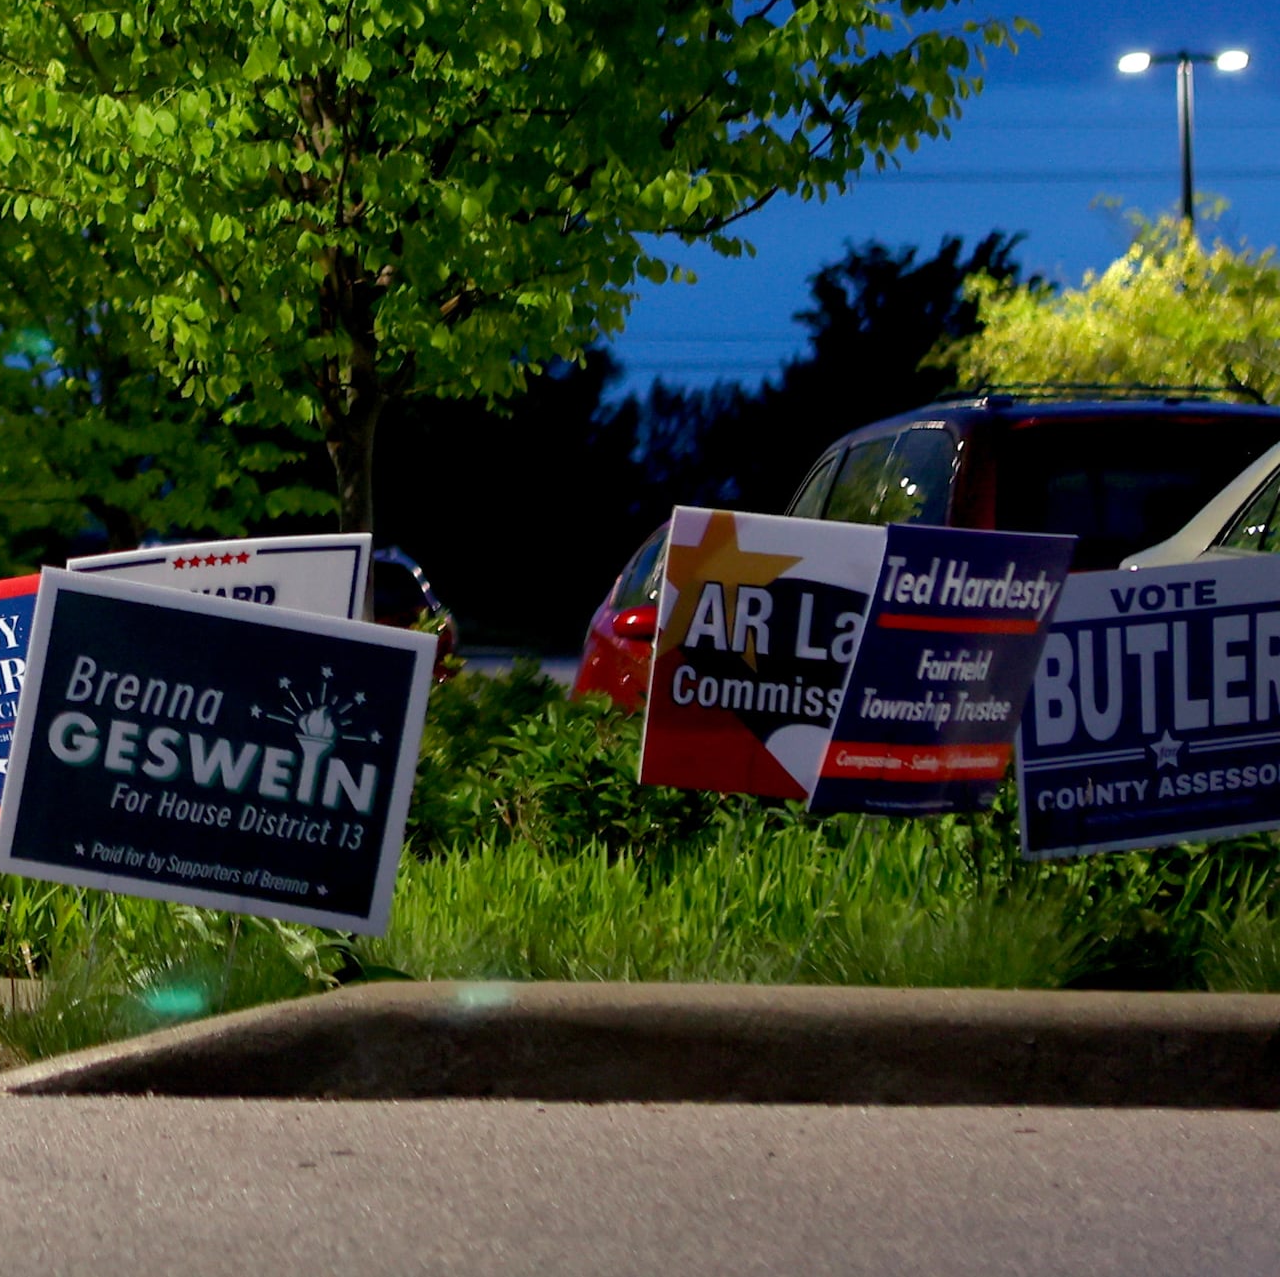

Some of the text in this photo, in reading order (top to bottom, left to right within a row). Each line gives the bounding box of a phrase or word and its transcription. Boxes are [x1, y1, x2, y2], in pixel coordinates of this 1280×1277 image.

[684, 581, 774, 656] AR
[883, 556, 1061, 622] Ted Hardesty
[1110, 580, 1217, 614] VOTE
[66, 655, 224, 726] Brenna
[917, 648, 993, 681] Fairfield
[1034, 610, 1280, 747] BUTLER
[860, 687, 1012, 731] Township Trustee
[48, 711, 378, 816] GESWEIN
[1038, 778, 1149, 812] COUNTY
[1158, 763, 1280, 799] ASSESSO
[111, 782, 365, 851] For House District 13
[91, 842, 310, 895] Paid for by Supporters of Brenna
